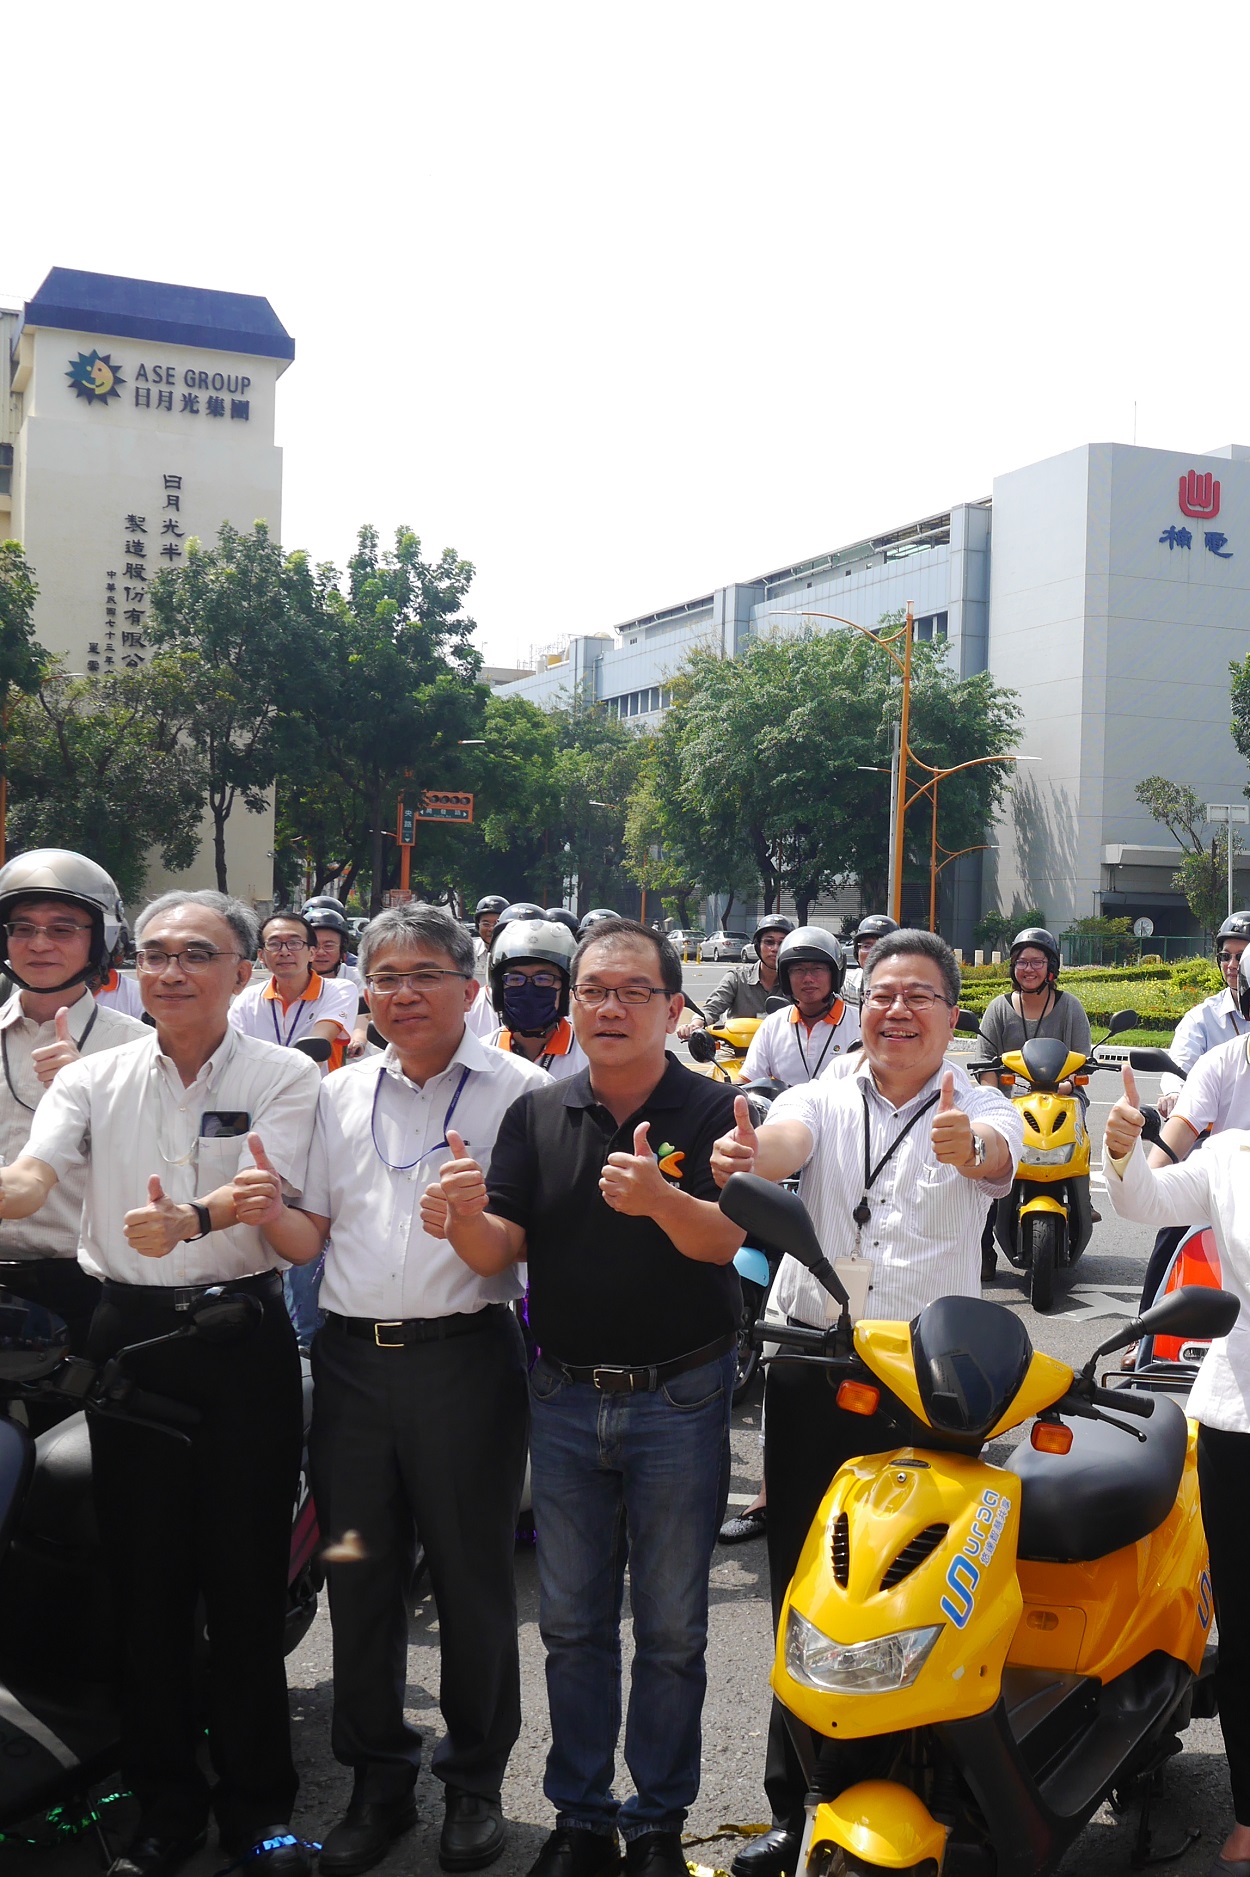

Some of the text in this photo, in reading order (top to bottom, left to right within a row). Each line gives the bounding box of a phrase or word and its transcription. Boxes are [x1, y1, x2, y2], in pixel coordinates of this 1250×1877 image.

[135, 363, 251, 395] ASE GROUP
[135, 386, 250, 421] 日月光集團
[122, 514, 148, 667] 製造股份有限公
